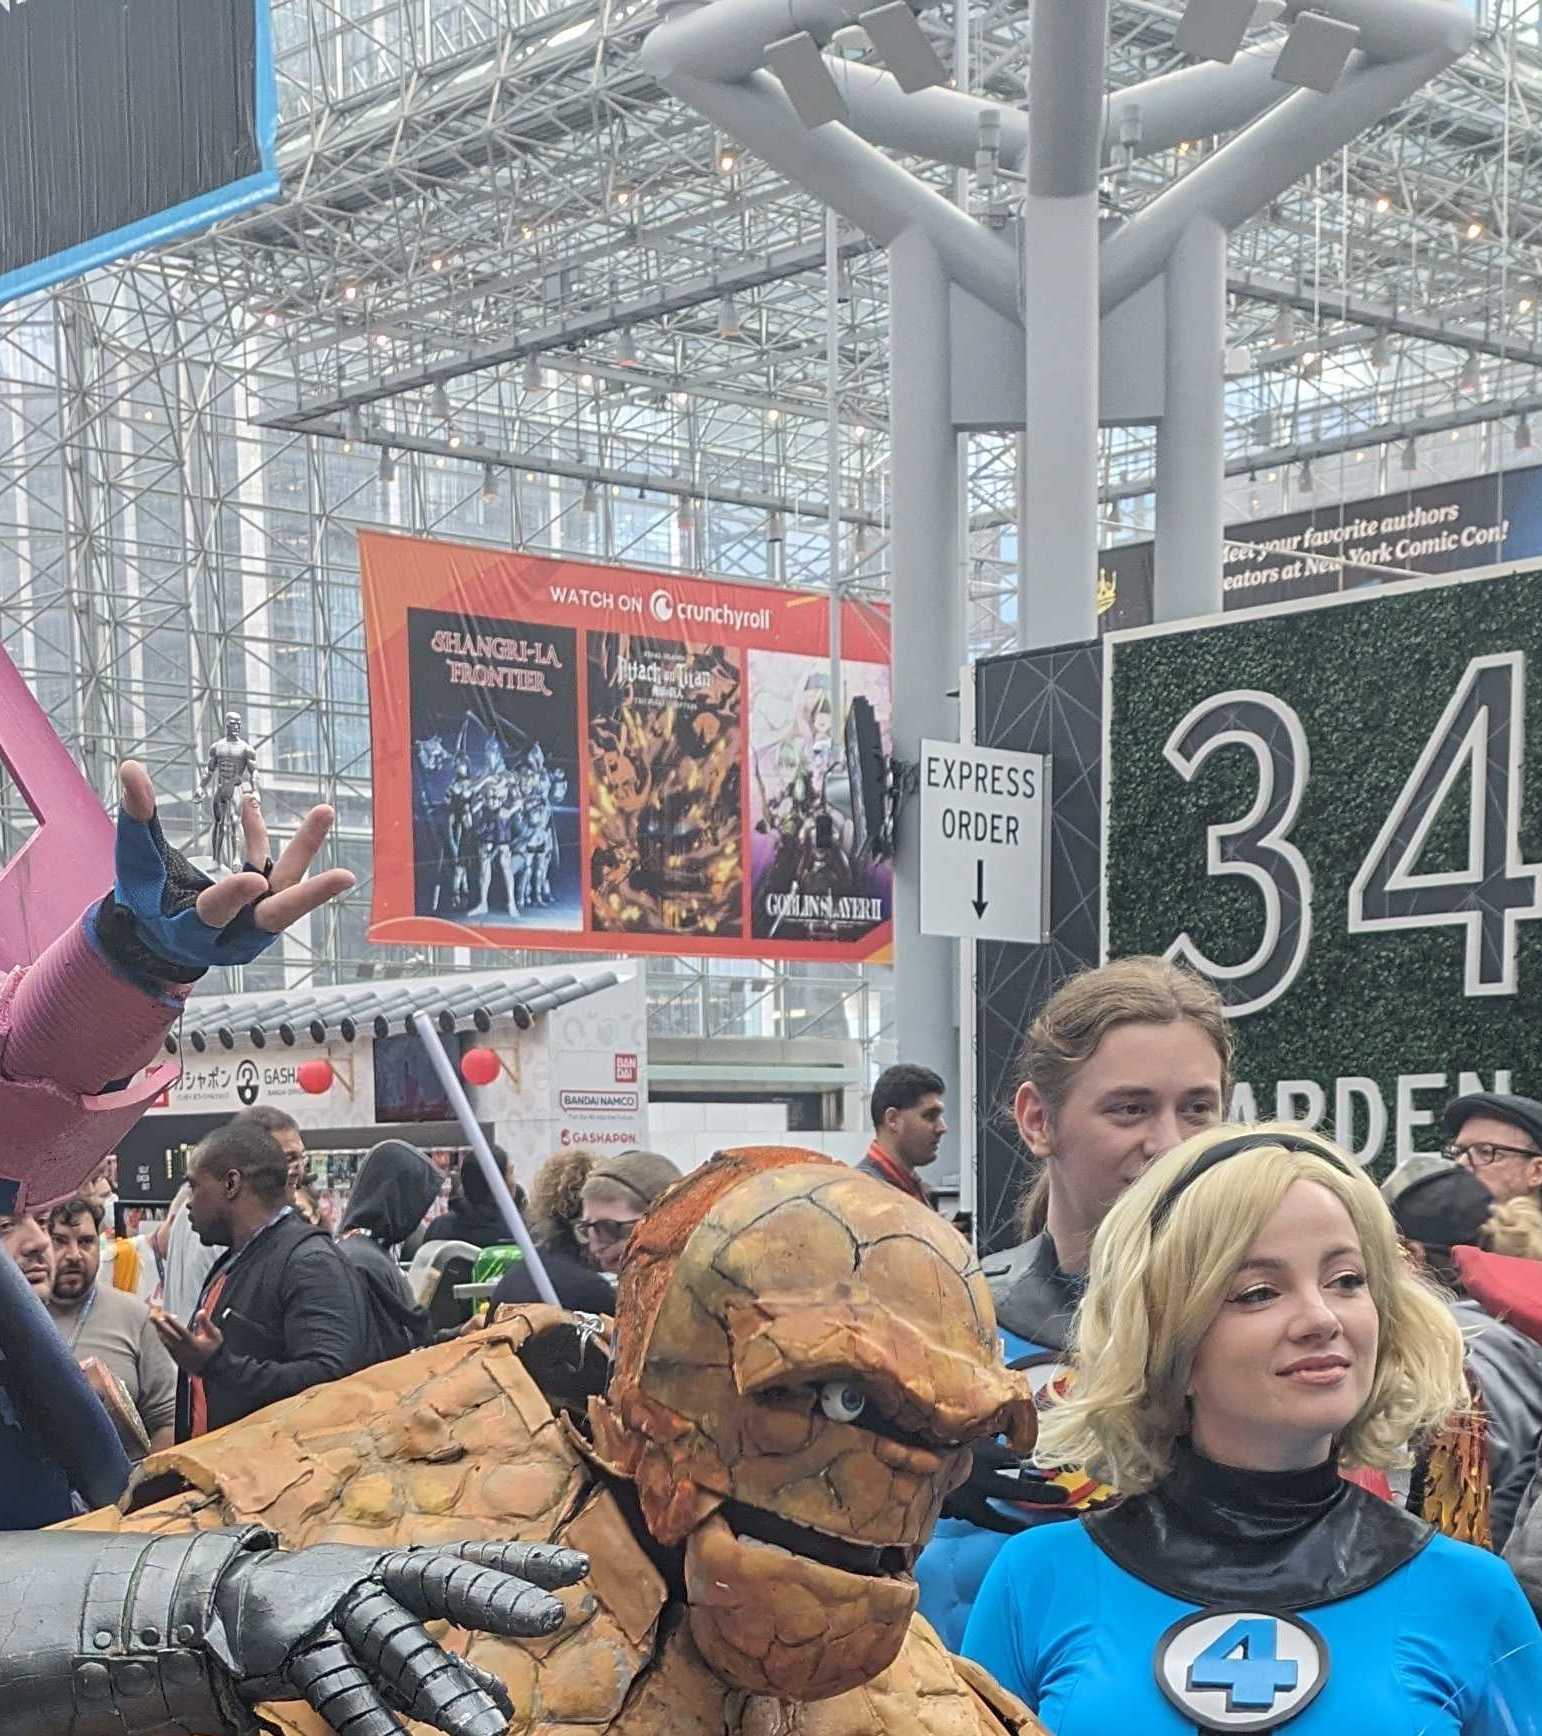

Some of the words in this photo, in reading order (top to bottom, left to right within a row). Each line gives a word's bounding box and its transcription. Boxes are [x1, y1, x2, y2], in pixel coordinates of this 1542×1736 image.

[1256, 534, 1302, 563] your
[1302, 518, 1378, 550] favorite
[1379, 504, 1460, 534] authors
[1280, 560, 1304, 581] at
[1303, 555, 1343, 578] New
[1347, 541, 1394, 567] York
[1394, 530, 1460, 560] Comic
[1460, 519, 1510, 548] Con!
[549, 586, 614, 610] WATCH
[618, 595, 643, 614] ON
[676, 603, 772, 631] crunchyroll
[430, 630, 564, 669] SHANGRI-LA
[445, 658, 554, 698] FRONTIER
[926, 756, 1036, 799] EXPRESS
[941, 808, 1019, 846] ORDER
[616, 1057, 636, 1067] BAN
[617, 1067, 632, 1080] DAI
[564, 1095, 599, 1106] BANDAI
[600, 1096, 635, 1107] NAMCO
[1227, 1069, 1513, 1168] ARDE
[572, 1131, 636, 1144] GASHAPON
[1185, 1618, 1298, 1713] 4
